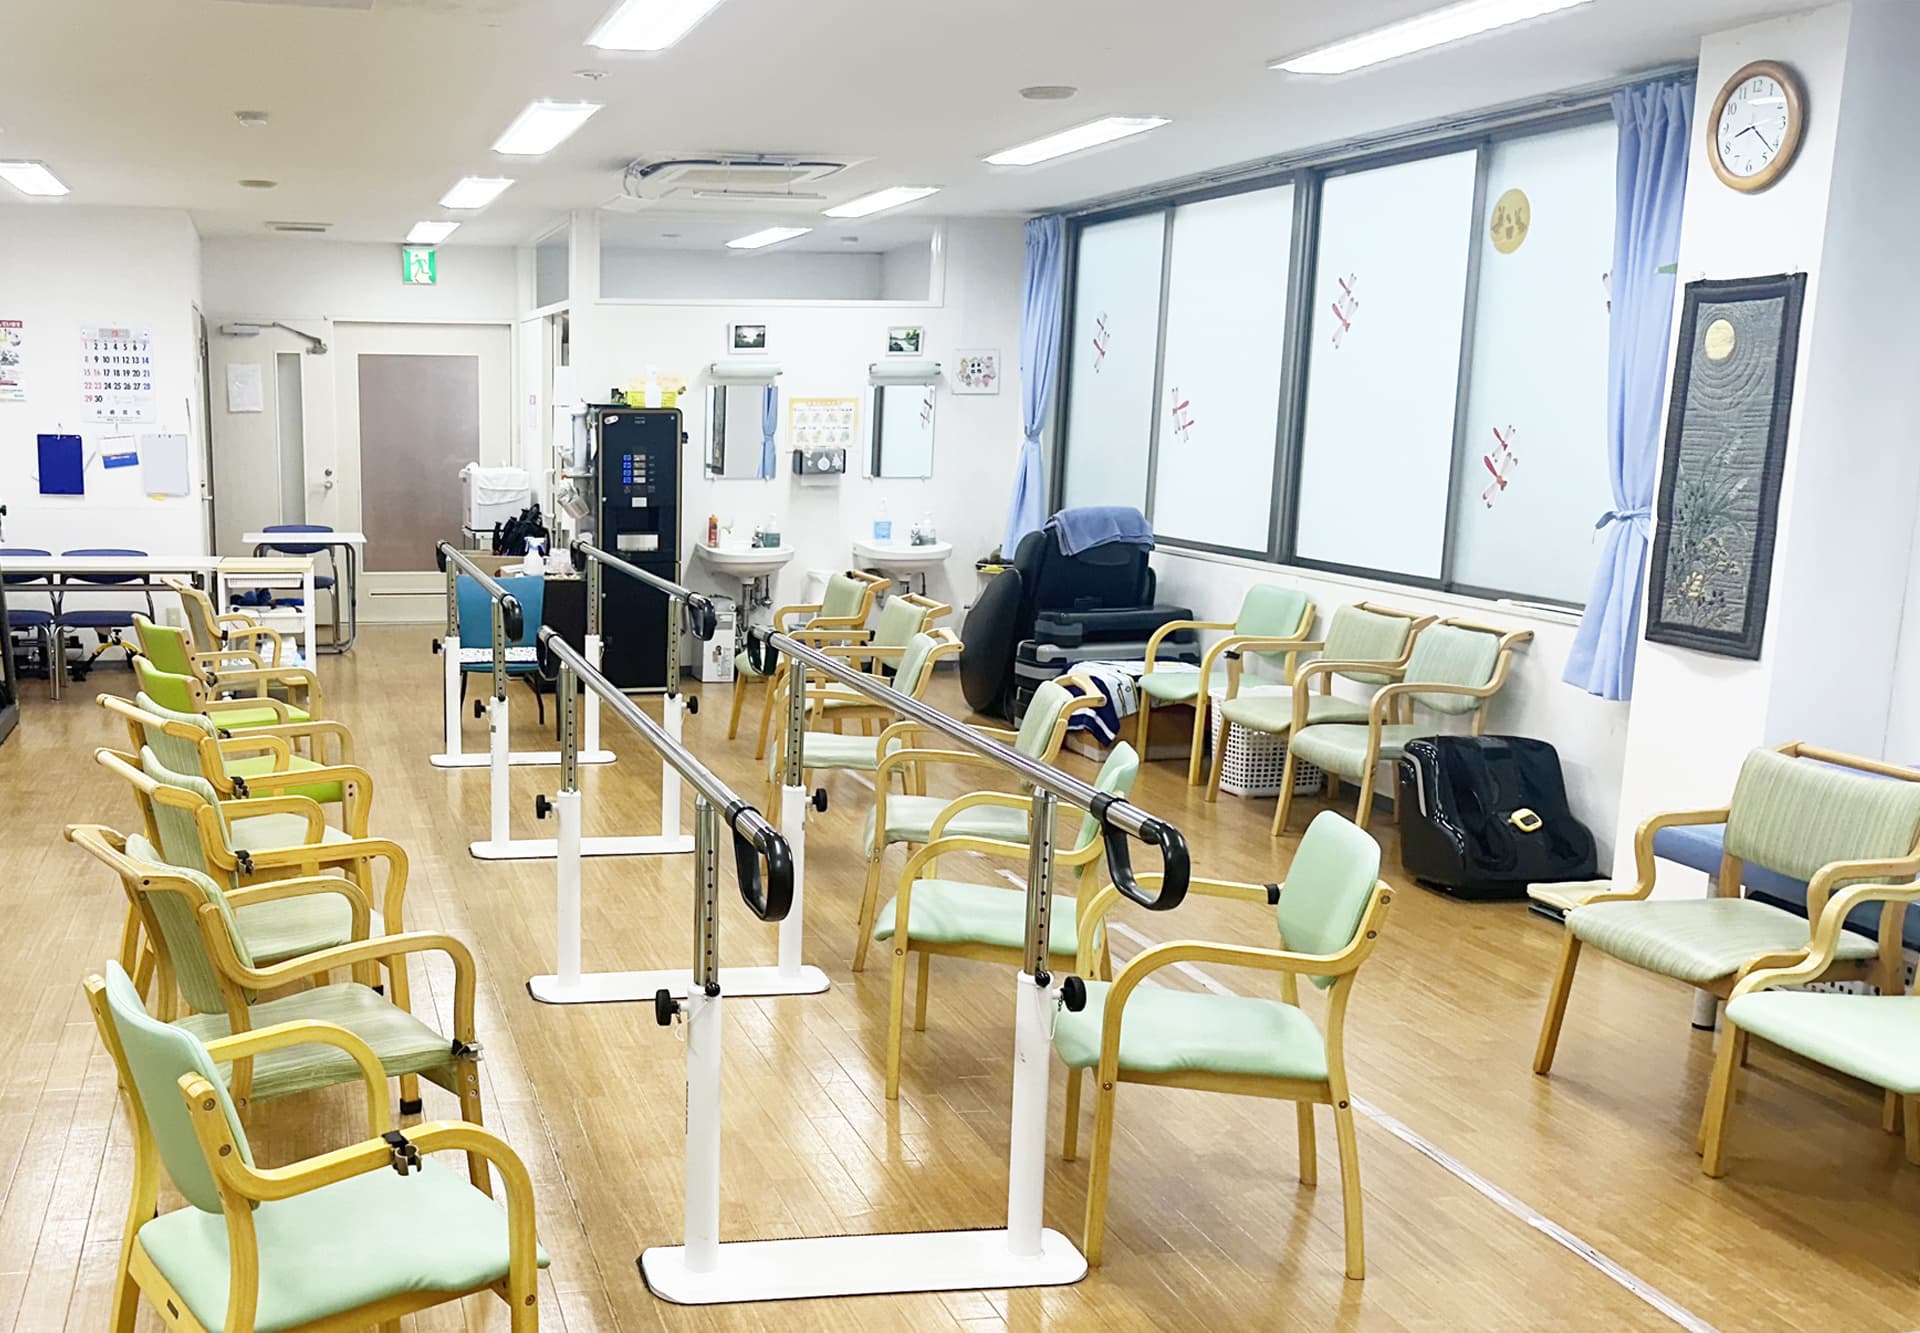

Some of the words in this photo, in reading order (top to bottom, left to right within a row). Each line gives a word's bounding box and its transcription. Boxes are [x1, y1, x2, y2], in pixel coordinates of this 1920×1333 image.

[1753, 80, 1763, 93] 12
[1770, 83, 1774, 96] 1
[1740, 87, 1747, 100] 11
[1728, 103, 1738, 116] 10
[1780, 116, 1786, 130] 3
[1724, 142, 1731, 155] 8
[1746, 160, 1753, 173] 6
[94, 342, 98, 350] 2
[104, 342, 108, 350] 3
[124, 343, 128, 351] 5
[133, 343, 138, 351] 6
[143, 343, 147, 351] 7
[94, 355, 99, 363] 9
[113, 356, 120, 364] 11
[122, 356, 130, 364] 12
[132, 356, 140, 364] 13
[114, 369, 120, 377] 18
[123, 369, 130, 377] 19
[84, 382, 92, 390] 22
[95, 382, 102, 390] 23
[104, 382, 112, 390] 24
[114, 382, 122, 390] 25
[94, 395, 103, 403] 30
